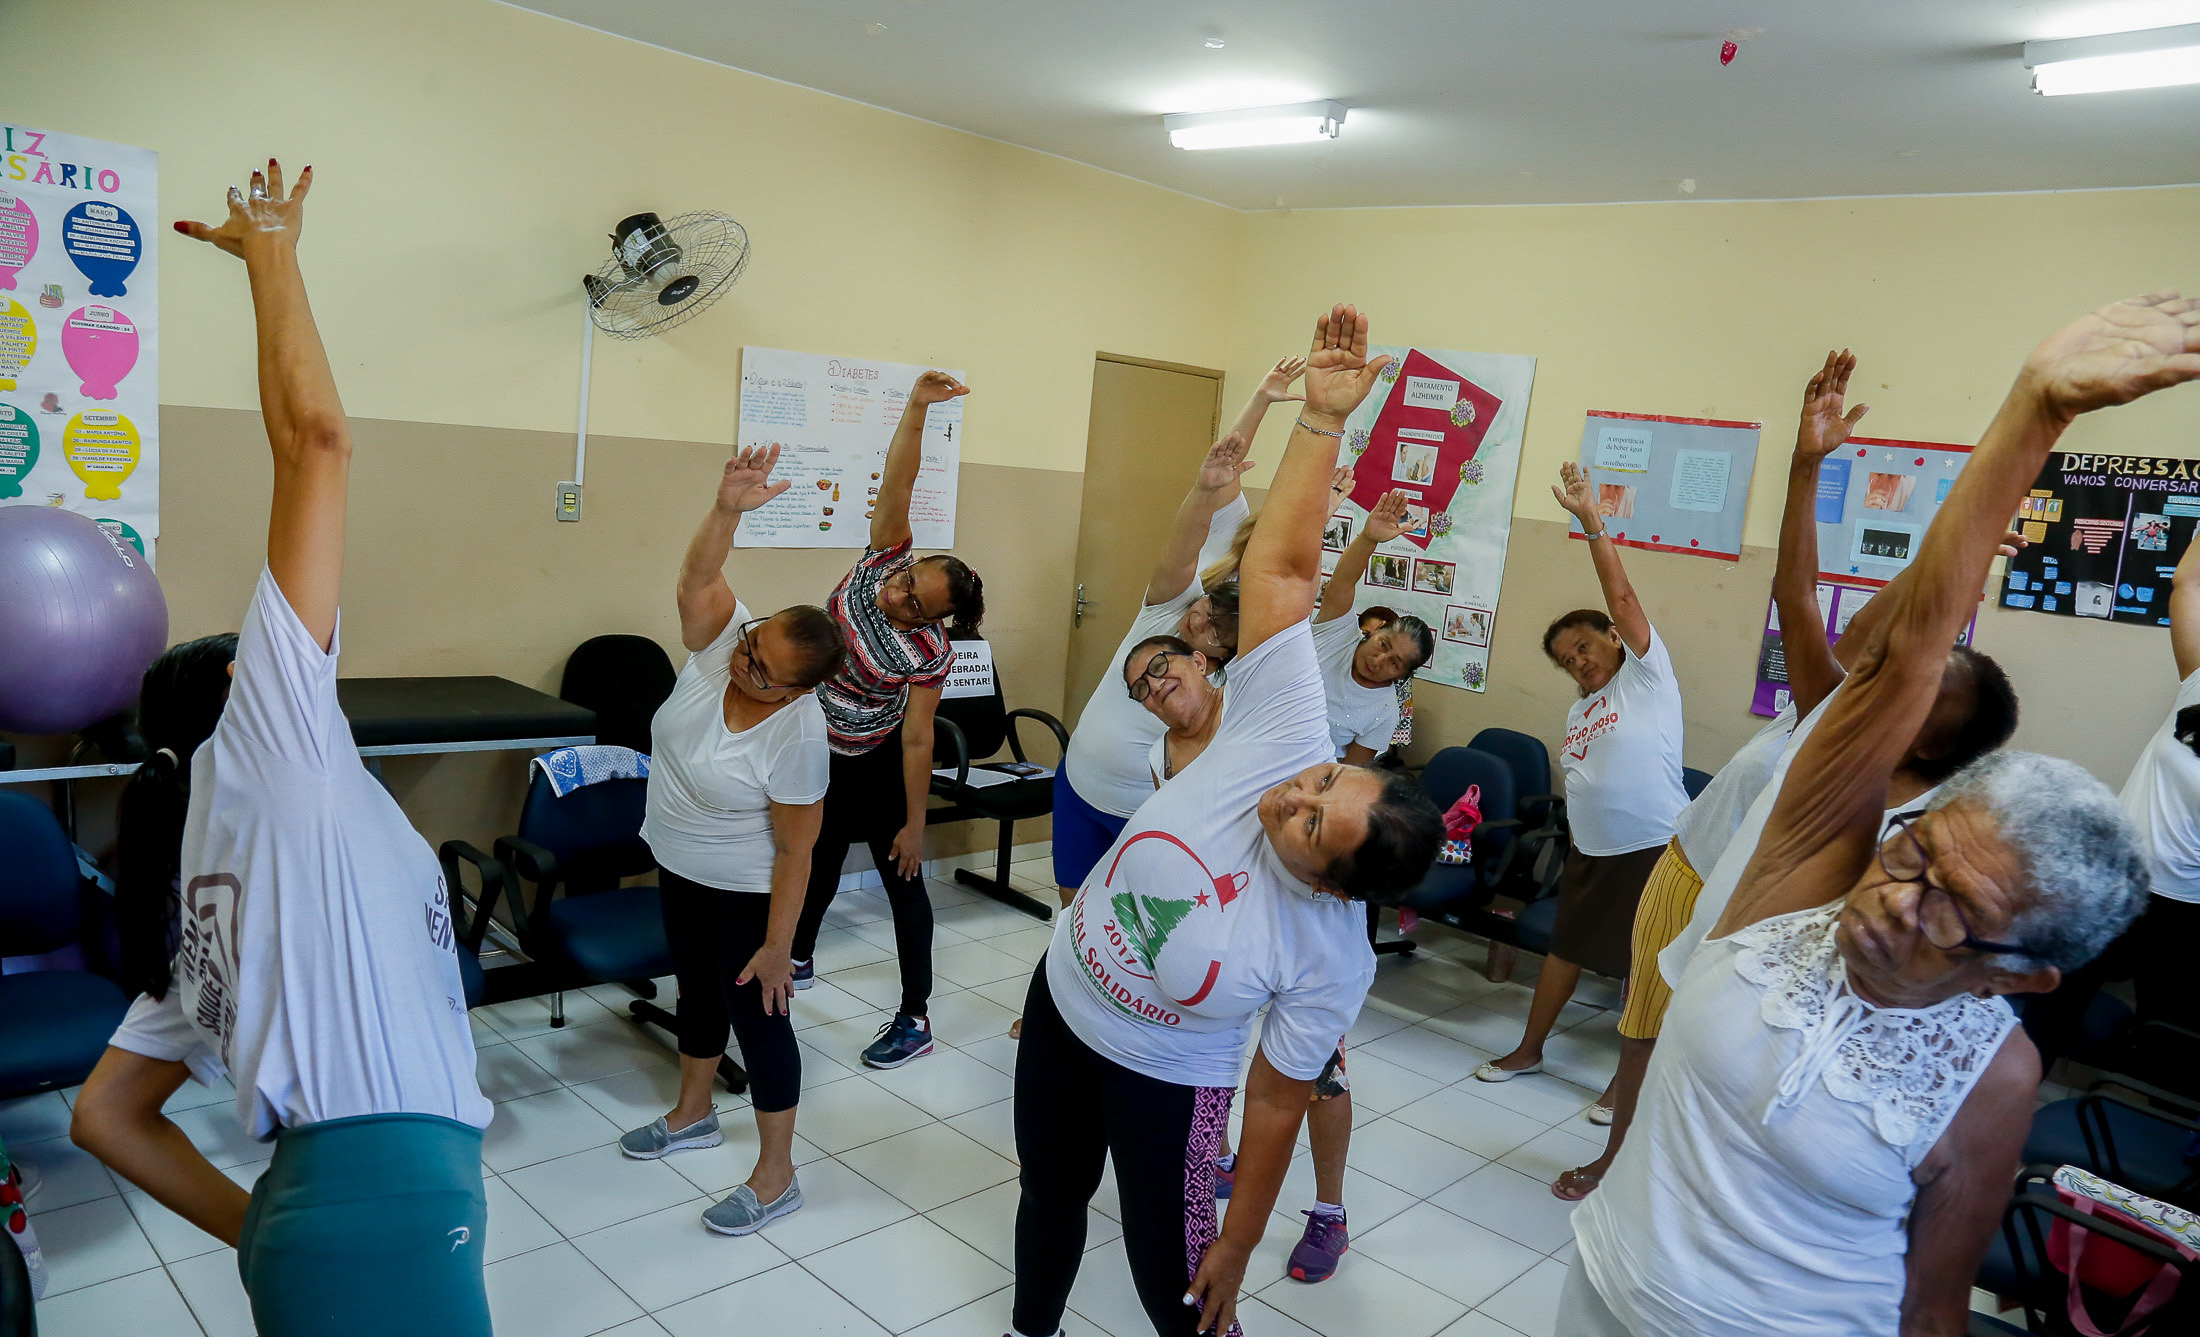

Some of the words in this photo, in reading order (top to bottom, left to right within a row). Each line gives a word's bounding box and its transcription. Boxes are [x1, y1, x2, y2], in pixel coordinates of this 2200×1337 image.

[0, 154, 120, 193] SÁRIO
[90, 208, 113, 216] MARÇO
[1413, 382, 1454, 392] TRATAMENTO
[1411, 392, 1444, 400] ALZHEIMER
[1614, 444, 1628, 452] beber
[2064, 473, 2107, 486] VAMOS
[2114, 476, 2199, 494] CONVERSAR
[952, 664, 990, 674] EBRADA!
[954, 677, 990, 686] SENTAR!
[1104, 919, 1138, 966] 2017
[1084, 947, 1181, 1026] SOLIDÁRIO
